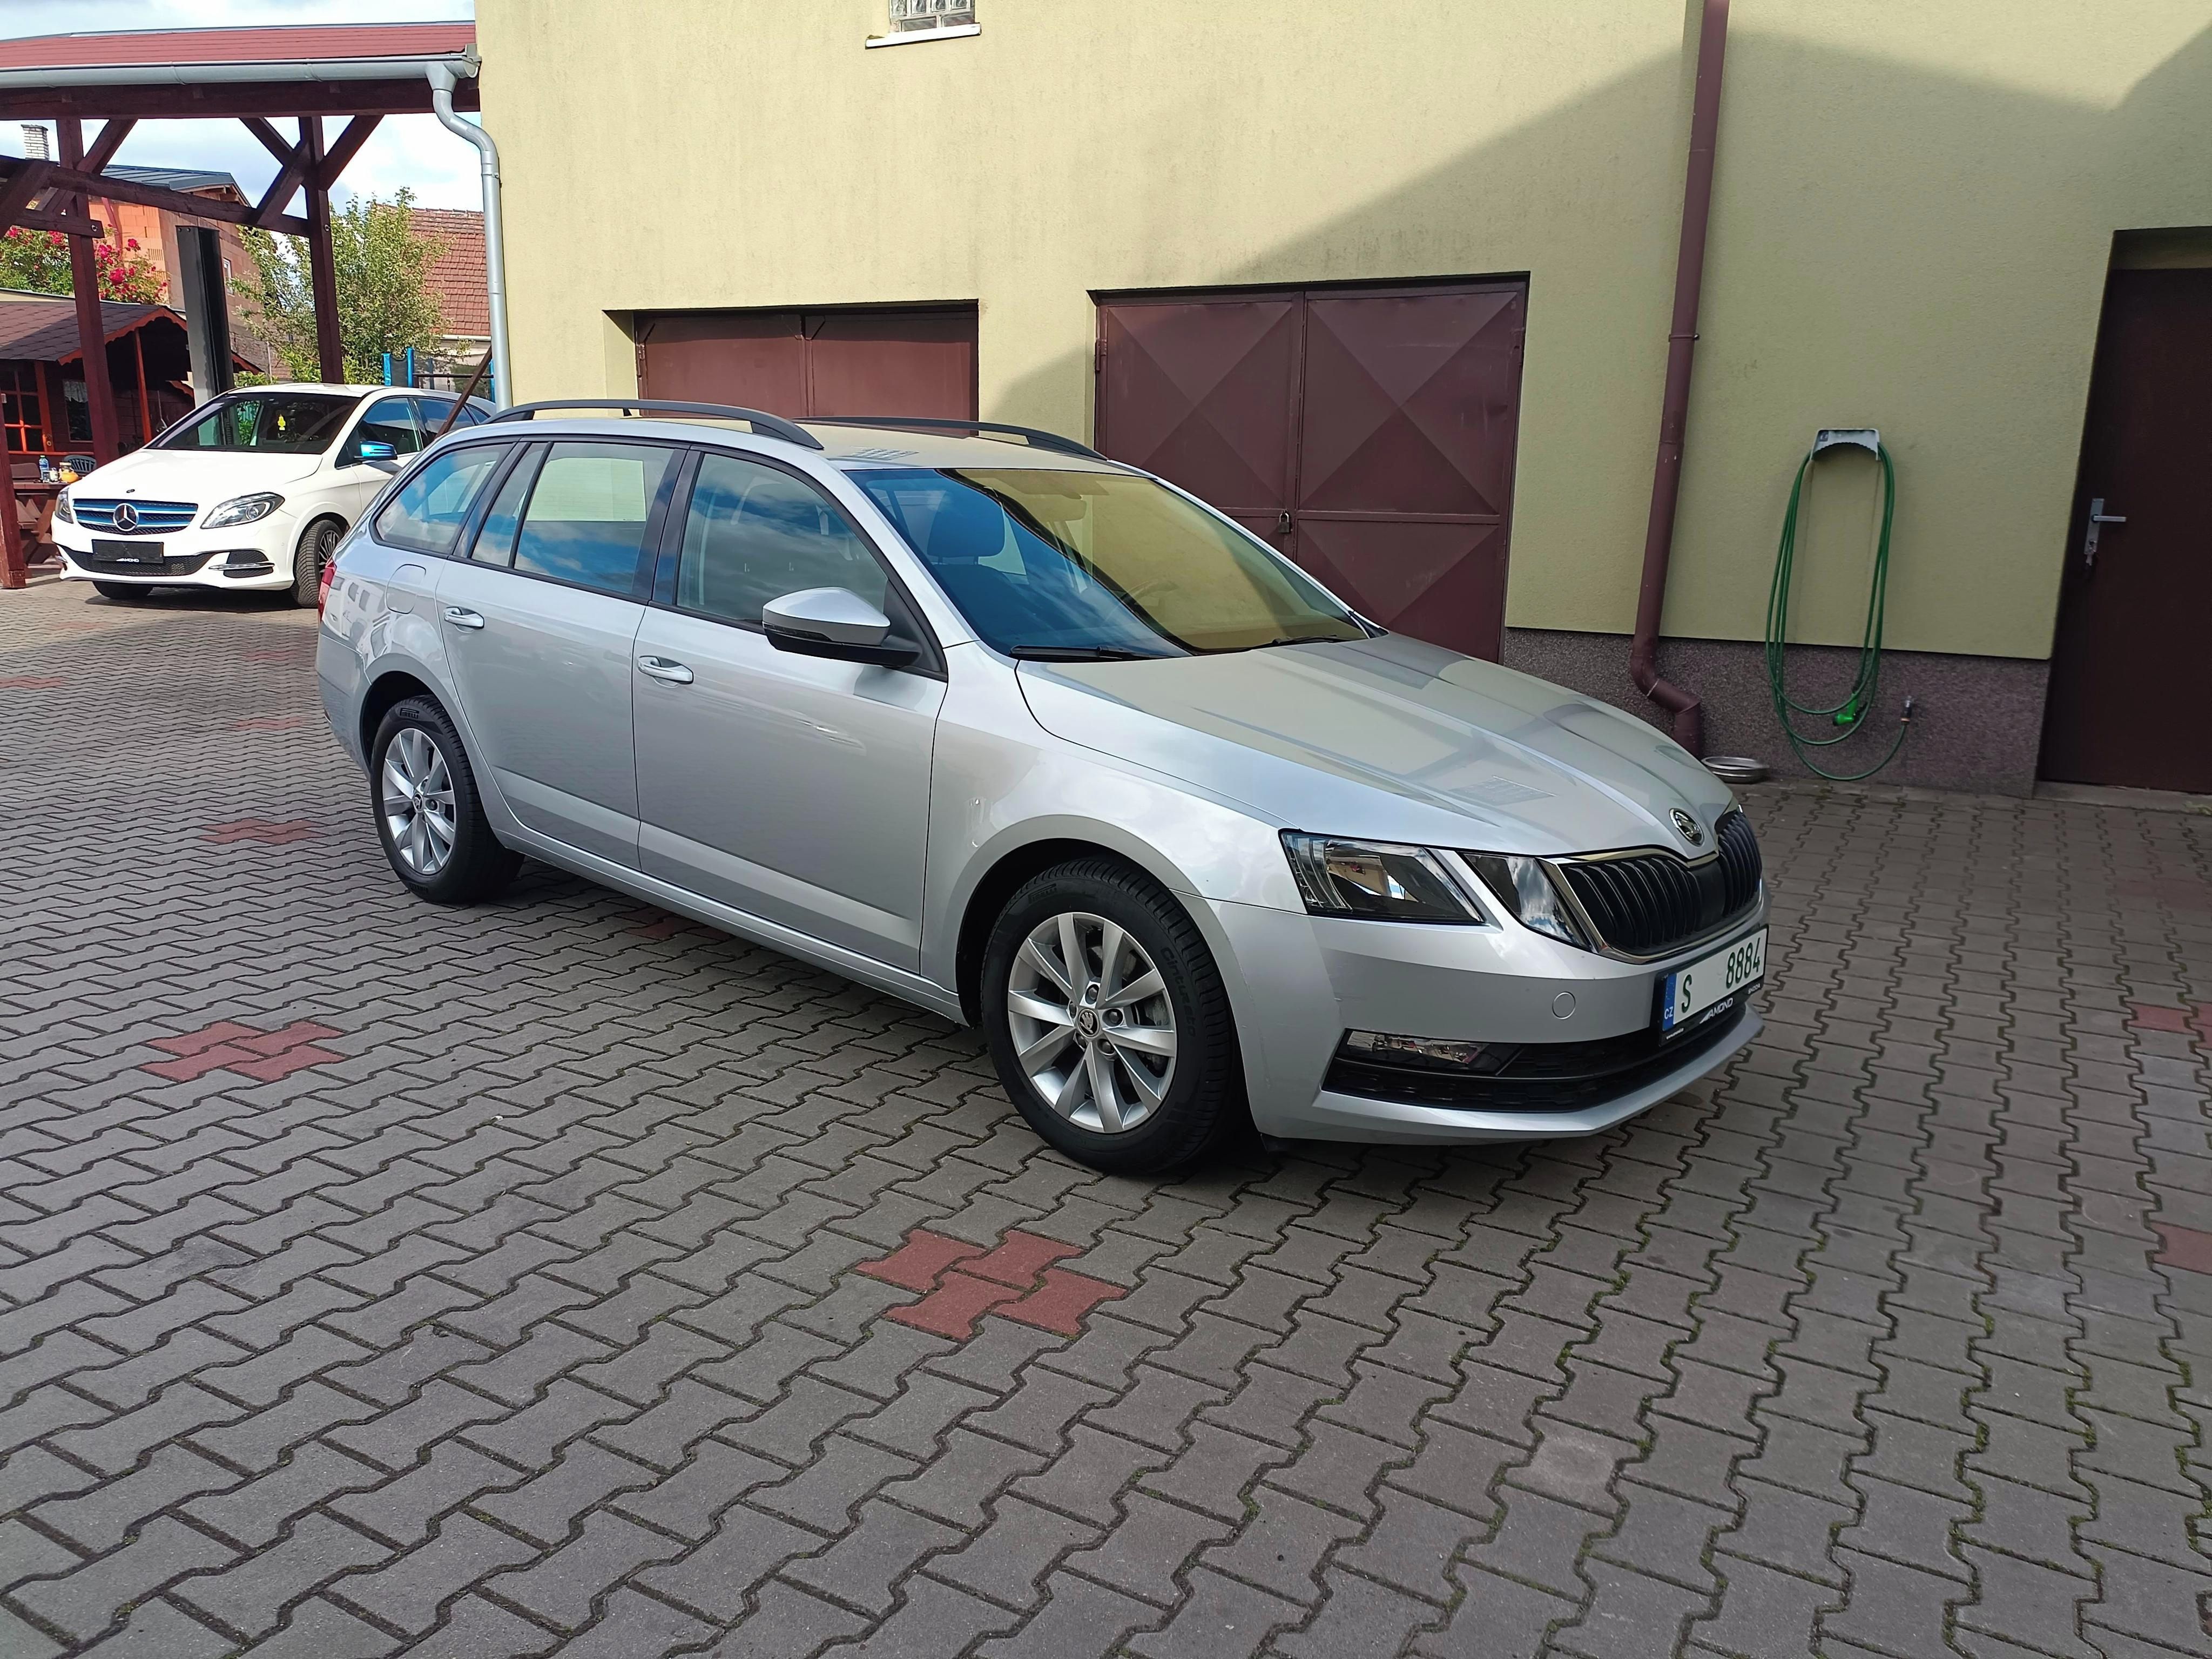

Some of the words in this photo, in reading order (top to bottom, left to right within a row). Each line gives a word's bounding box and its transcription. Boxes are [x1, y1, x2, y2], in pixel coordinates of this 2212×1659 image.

[1681, 974, 1692, 1014] S
[1725, 937, 1761, 990] 8884
[1664, 1006, 1674, 1020] CZ
[1700, 997, 1734, 1023] AMOND
